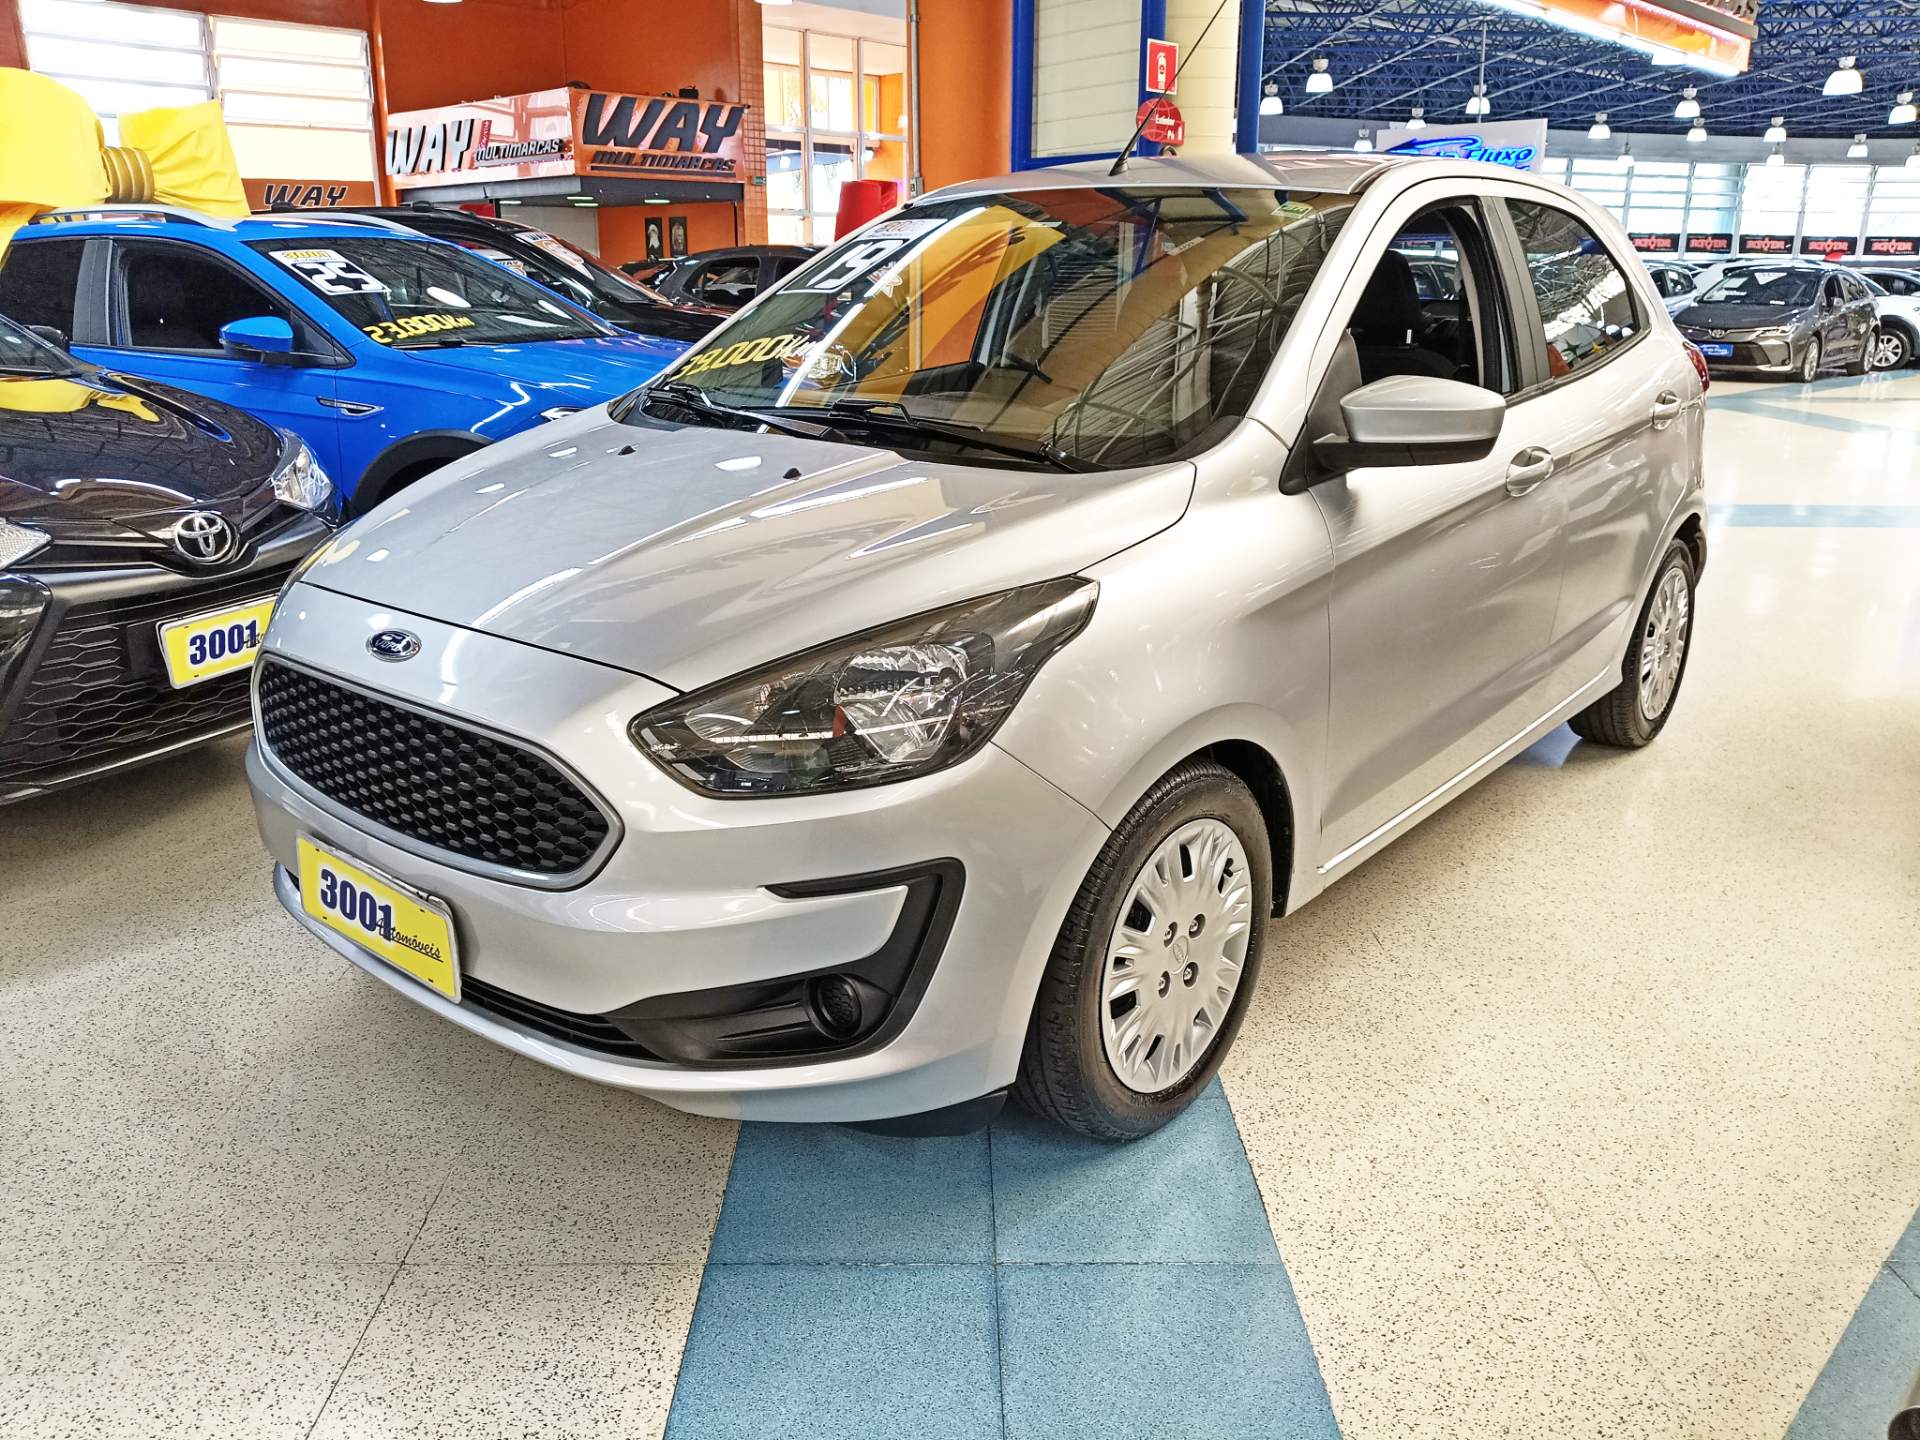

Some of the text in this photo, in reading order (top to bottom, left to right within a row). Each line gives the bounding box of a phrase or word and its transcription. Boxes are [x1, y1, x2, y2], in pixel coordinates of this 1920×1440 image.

[386, 118, 474, 175] WAY
[583, 94, 744, 153] WAY
[475, 138, 563, 161] MULTIMARCAS
[593, 150, 736, 172] MULTIMARCAS
[264, 184, 348, 207] WAY
[295, 262, 384, 293] 25
[806, 239, 904, 289] 19
[189, 620, 257, 666] 3001
[320, 868, 392, 942] 3001
